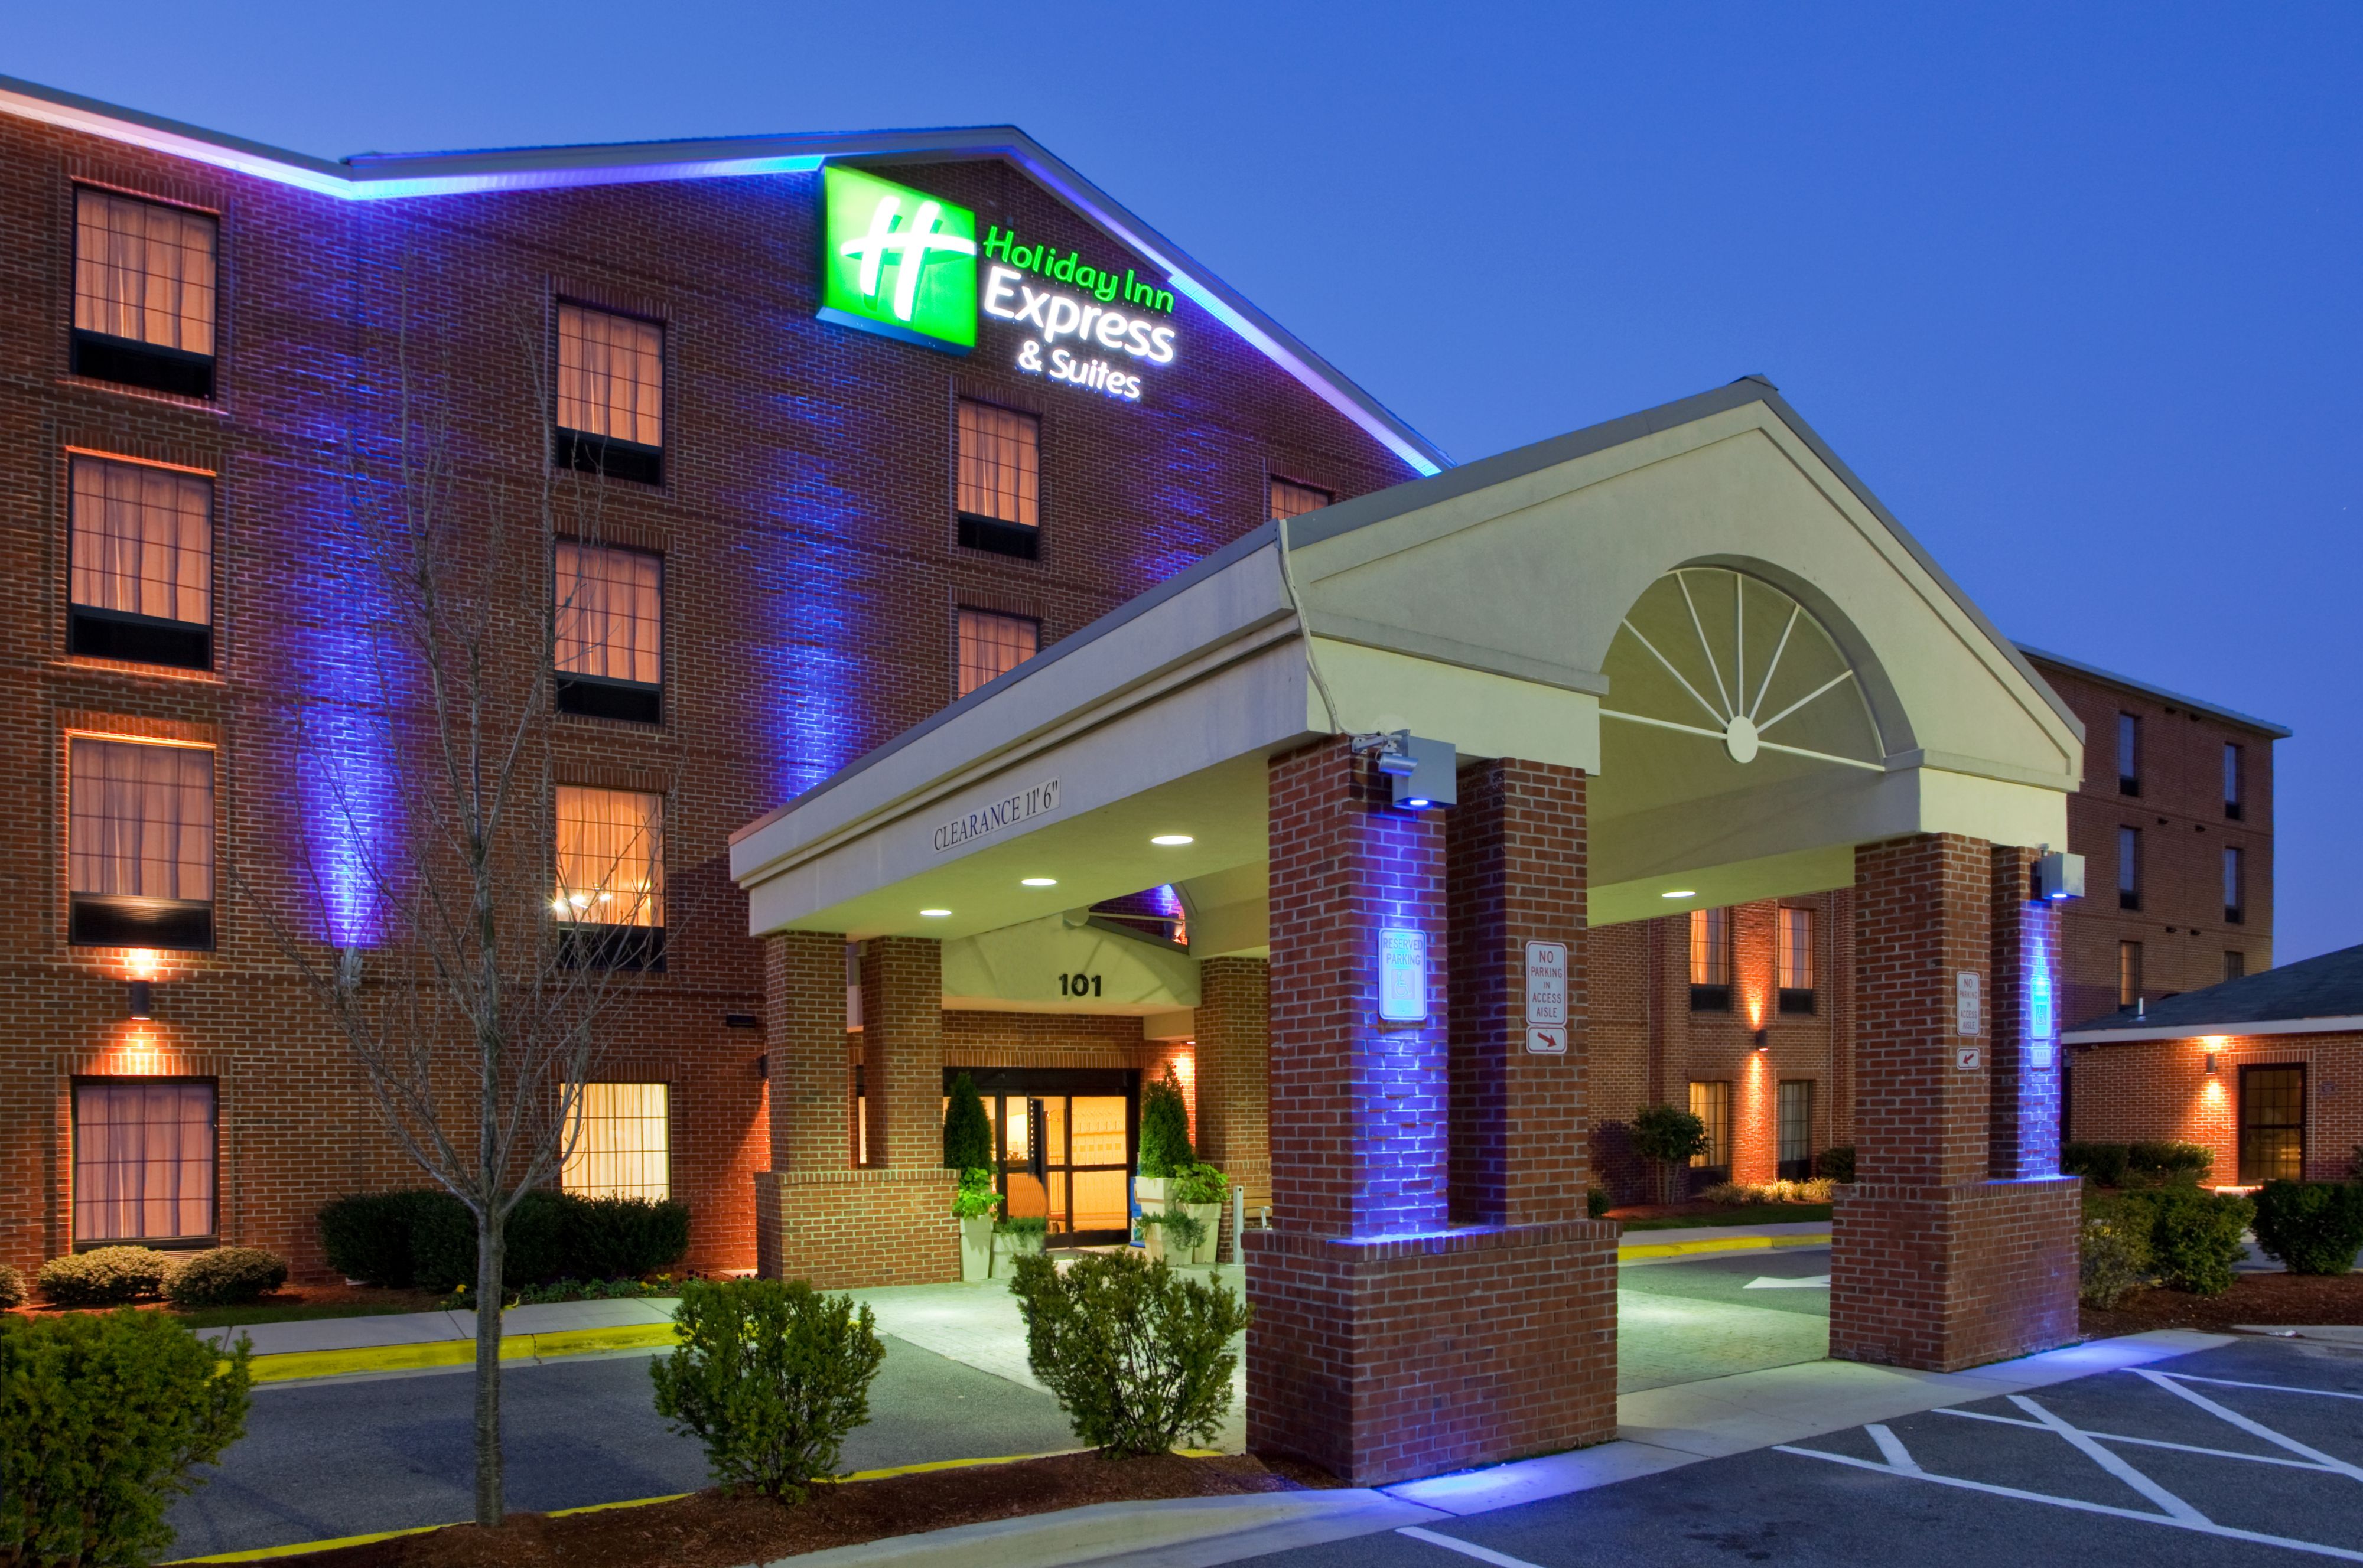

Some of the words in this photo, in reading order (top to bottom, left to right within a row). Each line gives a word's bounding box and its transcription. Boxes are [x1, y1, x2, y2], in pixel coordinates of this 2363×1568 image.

[983, 226, 1118, 301] Holiday
[1125, 269, 1174, 314] Inn
[984, 266, 1176, 363] Express
[1018, 340, 1042, 371] &
[1049, 349, 1141, 399] Suites
[934, 796, 1020, 850] CLEARANCE
[1383, 938, 1423, 950] RESERVED
[1386, 953, 1421, 965] PARKING
[1539, 951, 1554, 963] NO
[1531, 966, 1562, 978] PARKING
[1059, 973, 1101, 997] 101
[1964, 978, 1973, 988] NO
[1532, 993, 1561, 1003] ACCESS
[1537, 1007, 1557, 1018] AISLE
[1961, 1010, 1977, 1019] ACCESS
[1963, 1021, 1975, 1030] AISLE
